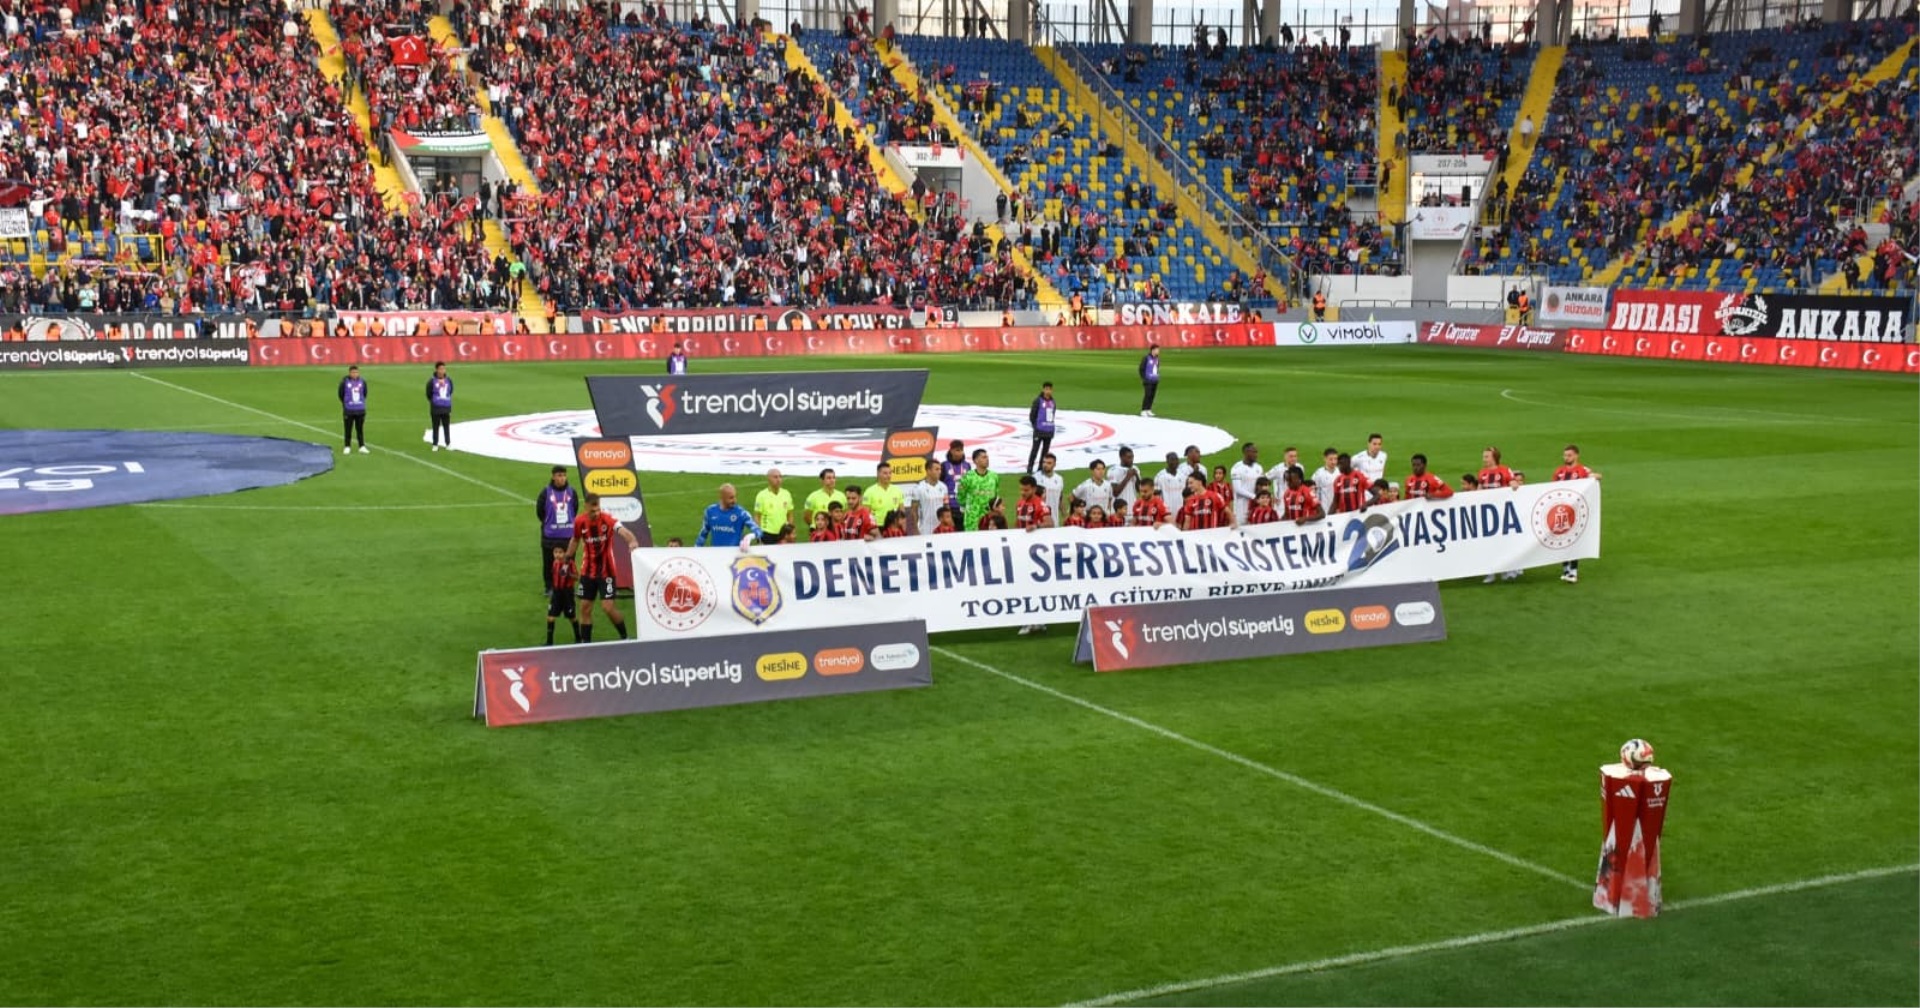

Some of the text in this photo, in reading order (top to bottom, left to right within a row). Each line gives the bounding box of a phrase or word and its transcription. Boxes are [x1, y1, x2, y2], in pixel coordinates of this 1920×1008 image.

[1565, 292, 1603, 302] ANKARA
[1121, 302, 1242, 325] SON KALE
[1611, 303, 1702, 333] BURASI
[1775, 307, 1904, 342] ANKARA
[136, 347, 198, 362] trendyol
[681, 387, 794, 417] trendyol
[584, 449, 626, 460] trendyol
[591, 475, 631, 487] NESİNE
[792, 537, 1015, 601] DENETİMLİ
[1223, 522, 1337, 573] SİSTEMİ
[1397, 501, 1524, 553] YAŞINDA
[961, 592, 1099, 618] TOPLUMA
[1142, 616, 1228, 643] trendyol
[1353, 611, 1386, 624] trendyol
[549, 662, 658, 693] trendyol
[762, 658, 801, 674] NESİNE
[818, 653, 860, 667] trendyol
